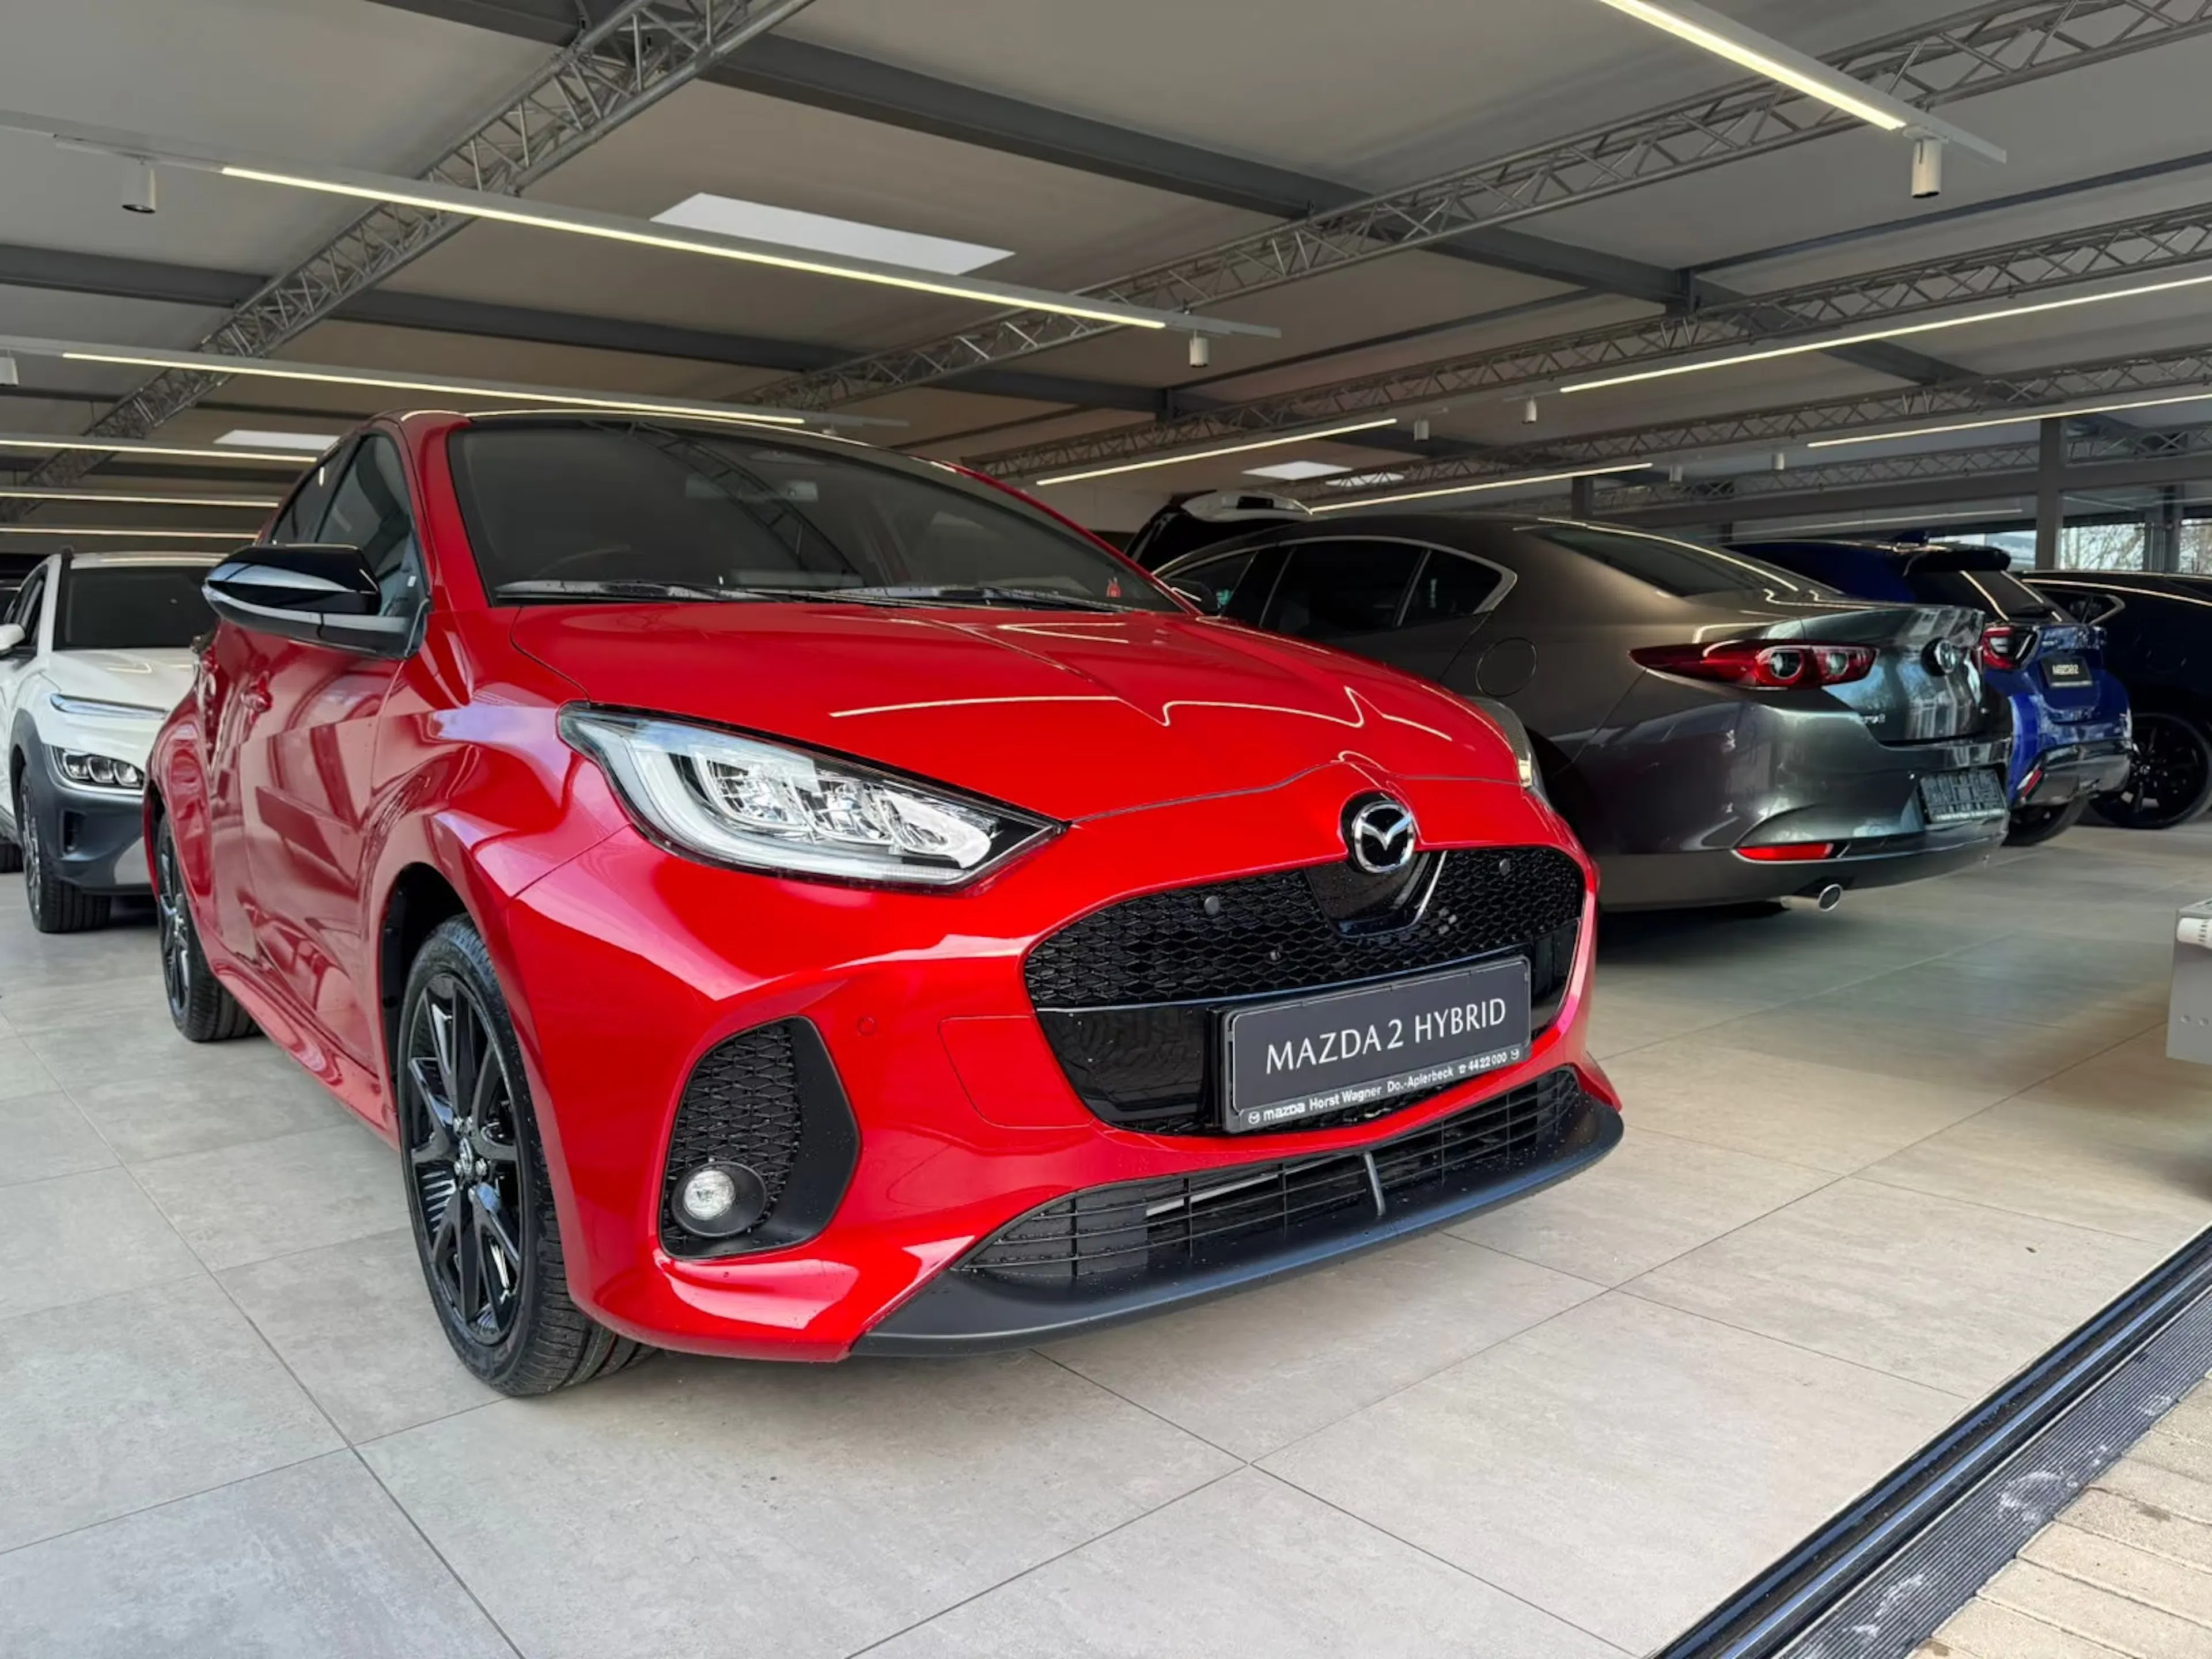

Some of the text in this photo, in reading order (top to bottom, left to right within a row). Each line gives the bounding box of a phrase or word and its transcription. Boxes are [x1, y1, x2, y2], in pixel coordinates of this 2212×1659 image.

[1266, 997, 1506, 1075] MAZDA 2 HYBRID
[1263, 1102, 1306, 1122] mazda
[1309, 1094, 1340, 1111] Horst
[1342, 1085, 1382, 1103] Wagner
